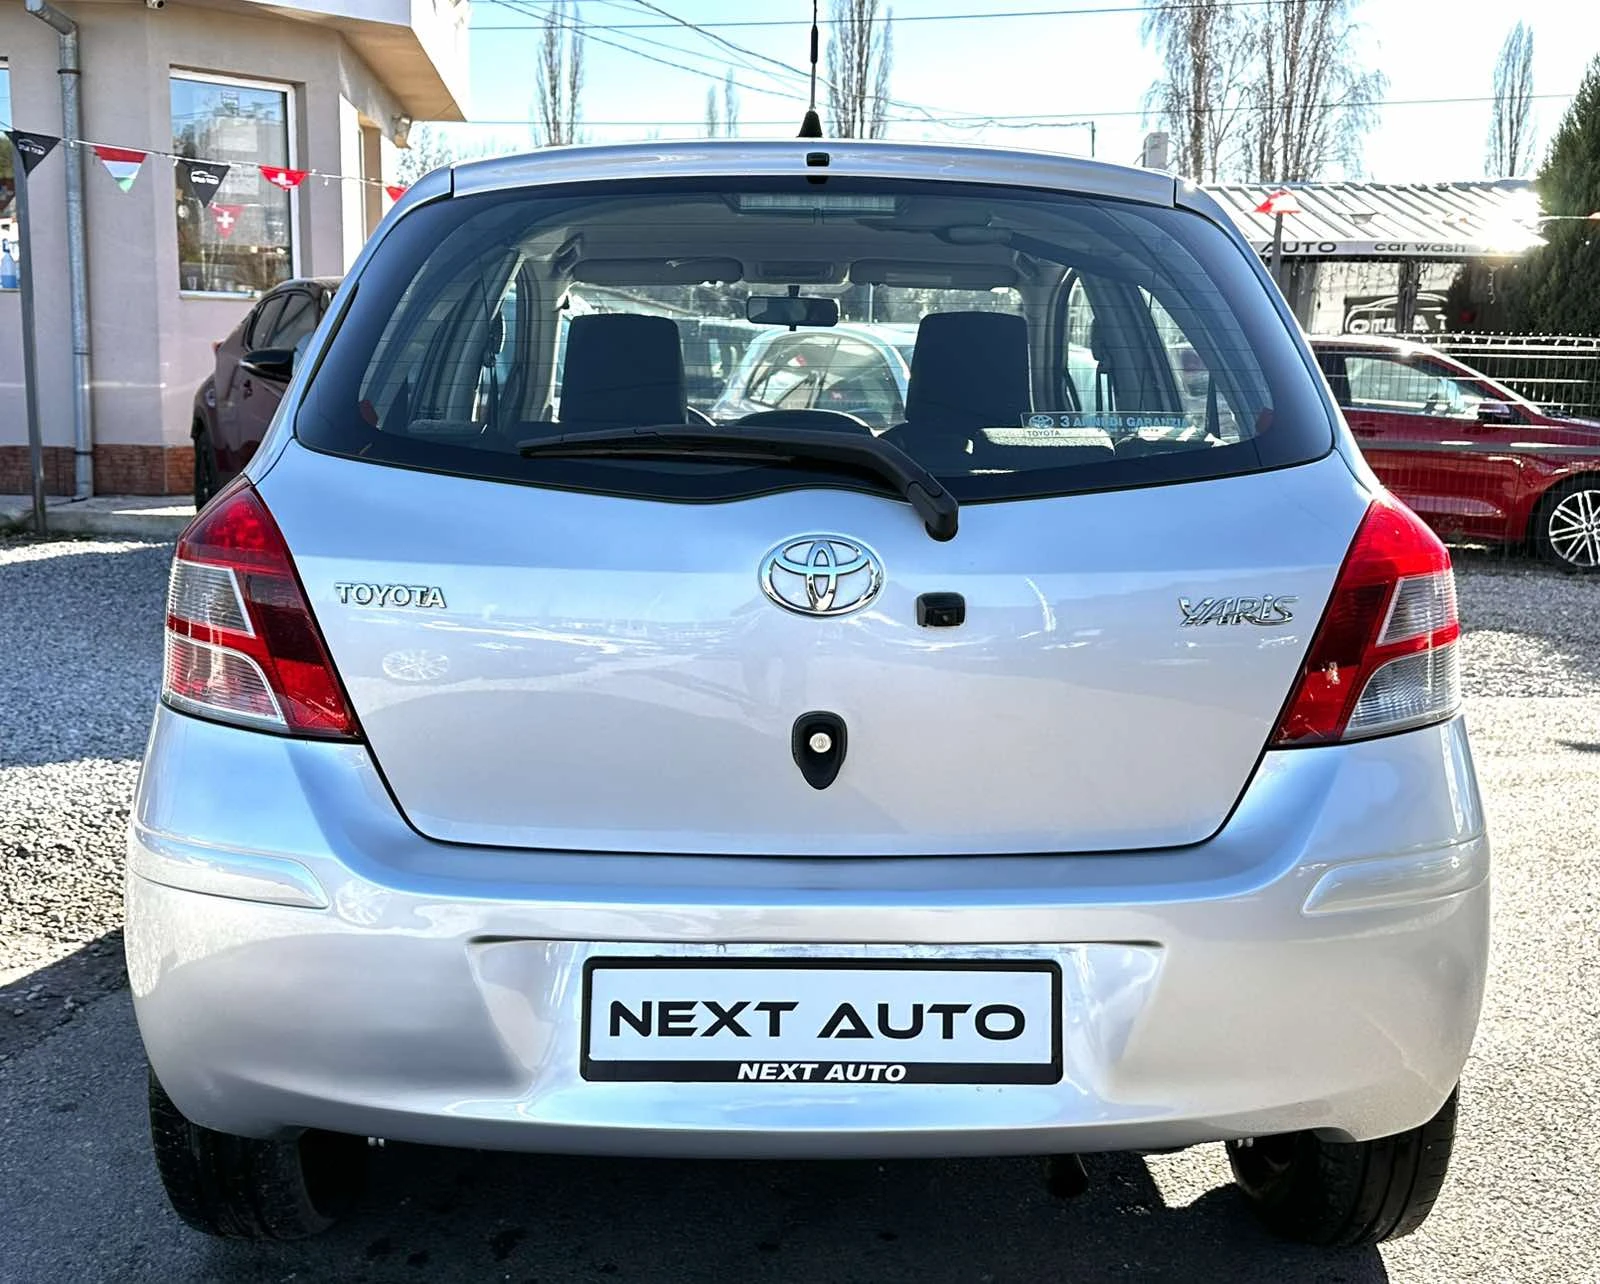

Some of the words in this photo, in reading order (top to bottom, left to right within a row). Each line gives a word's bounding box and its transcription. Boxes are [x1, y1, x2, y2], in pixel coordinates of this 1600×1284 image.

[1374, 243, 1407, 252] car
[1415, 243, 1466, 253] wash
[1060, 415, 1070, 427] 3
[335, 582, 447, 609] TOYOTA
[609, 1000, 799, 1037] NEXT
[816, 1002, 1026, 1040] AUTO
[737, 1063, 819, 1080] NEXT
[824, 1063, 907, 1081] AUTO
